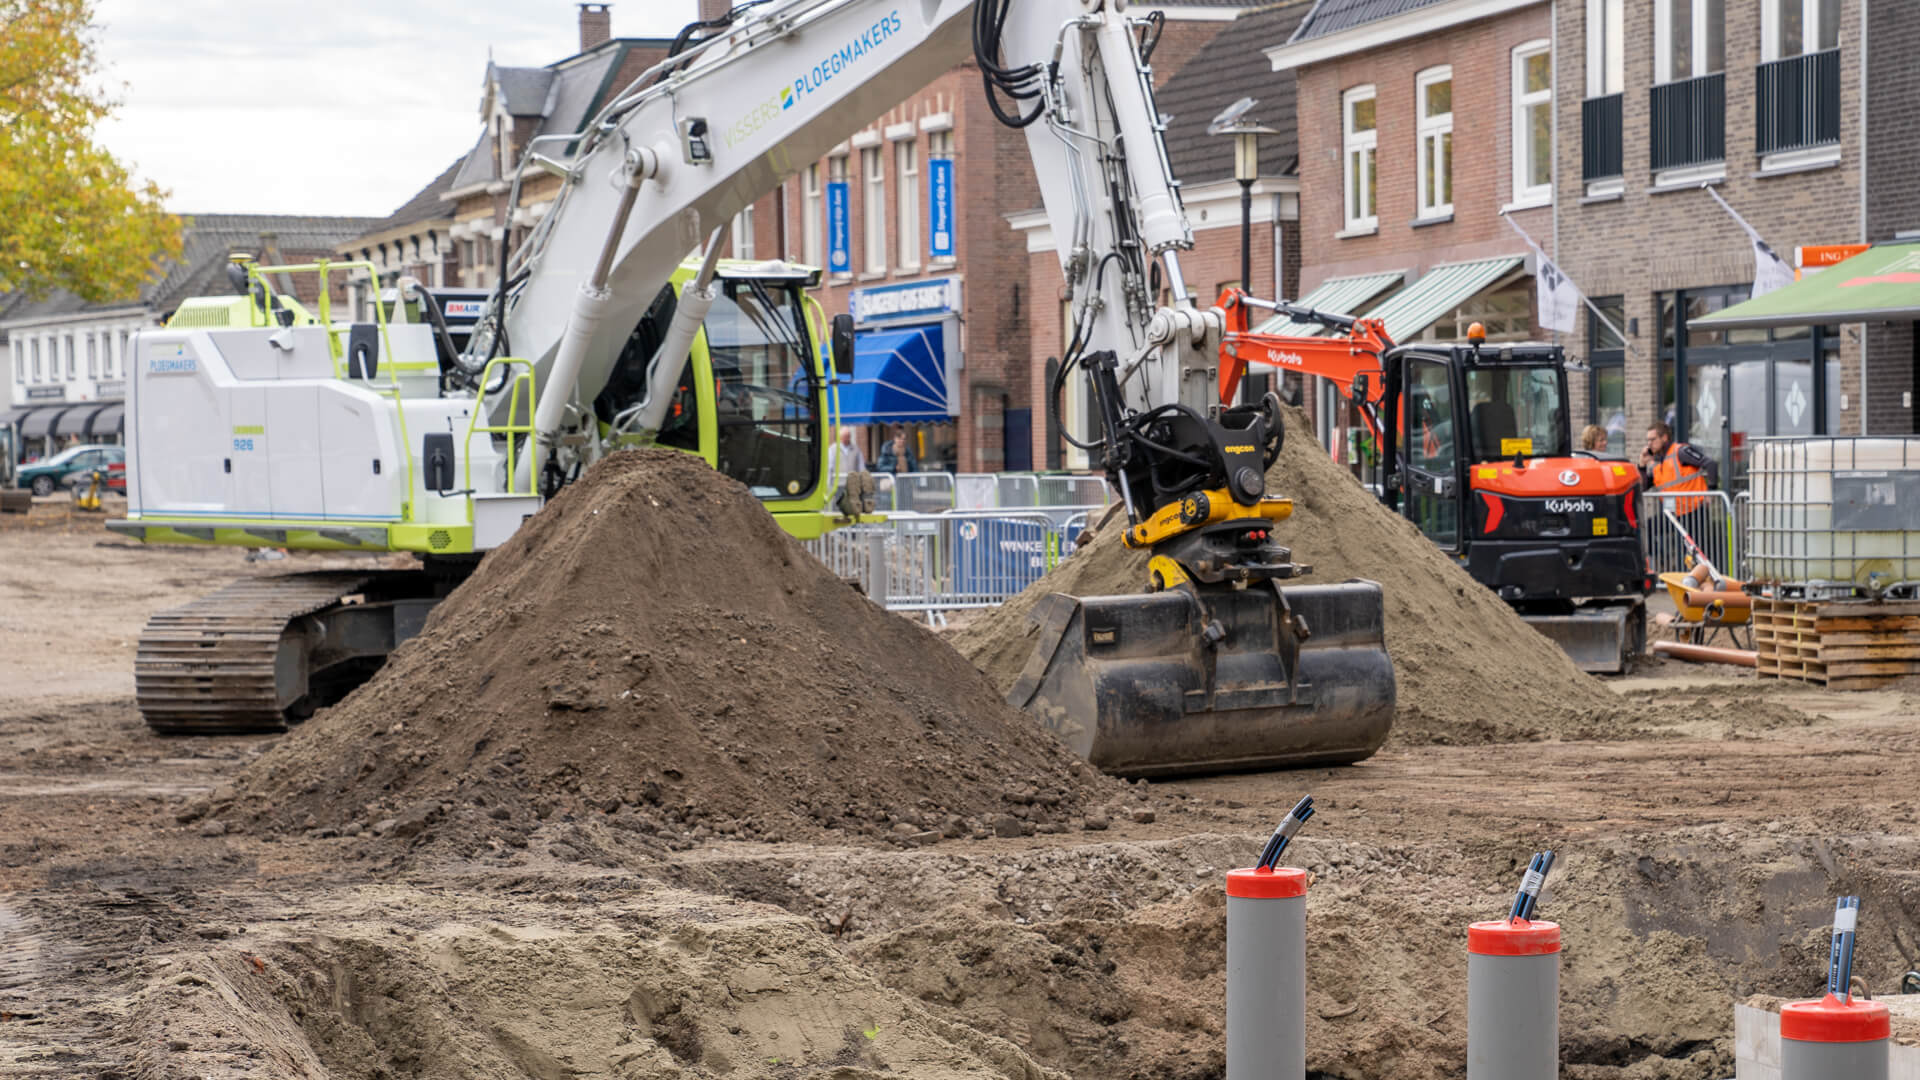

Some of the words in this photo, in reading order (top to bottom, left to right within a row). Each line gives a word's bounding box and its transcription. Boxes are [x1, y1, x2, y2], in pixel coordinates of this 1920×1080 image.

[724, 96, 781, 149] VISSERS
[795, 10, 901, 100] PLOEGMAKERS
[1820, 251, 1841, 262] ING
[1267, 349, 1303, 366] Kubota
[233, 439, 254, 451] 926
[1224, 445, 1255, 454] engcon
[1545, 500, 1594, 513] Kubota
